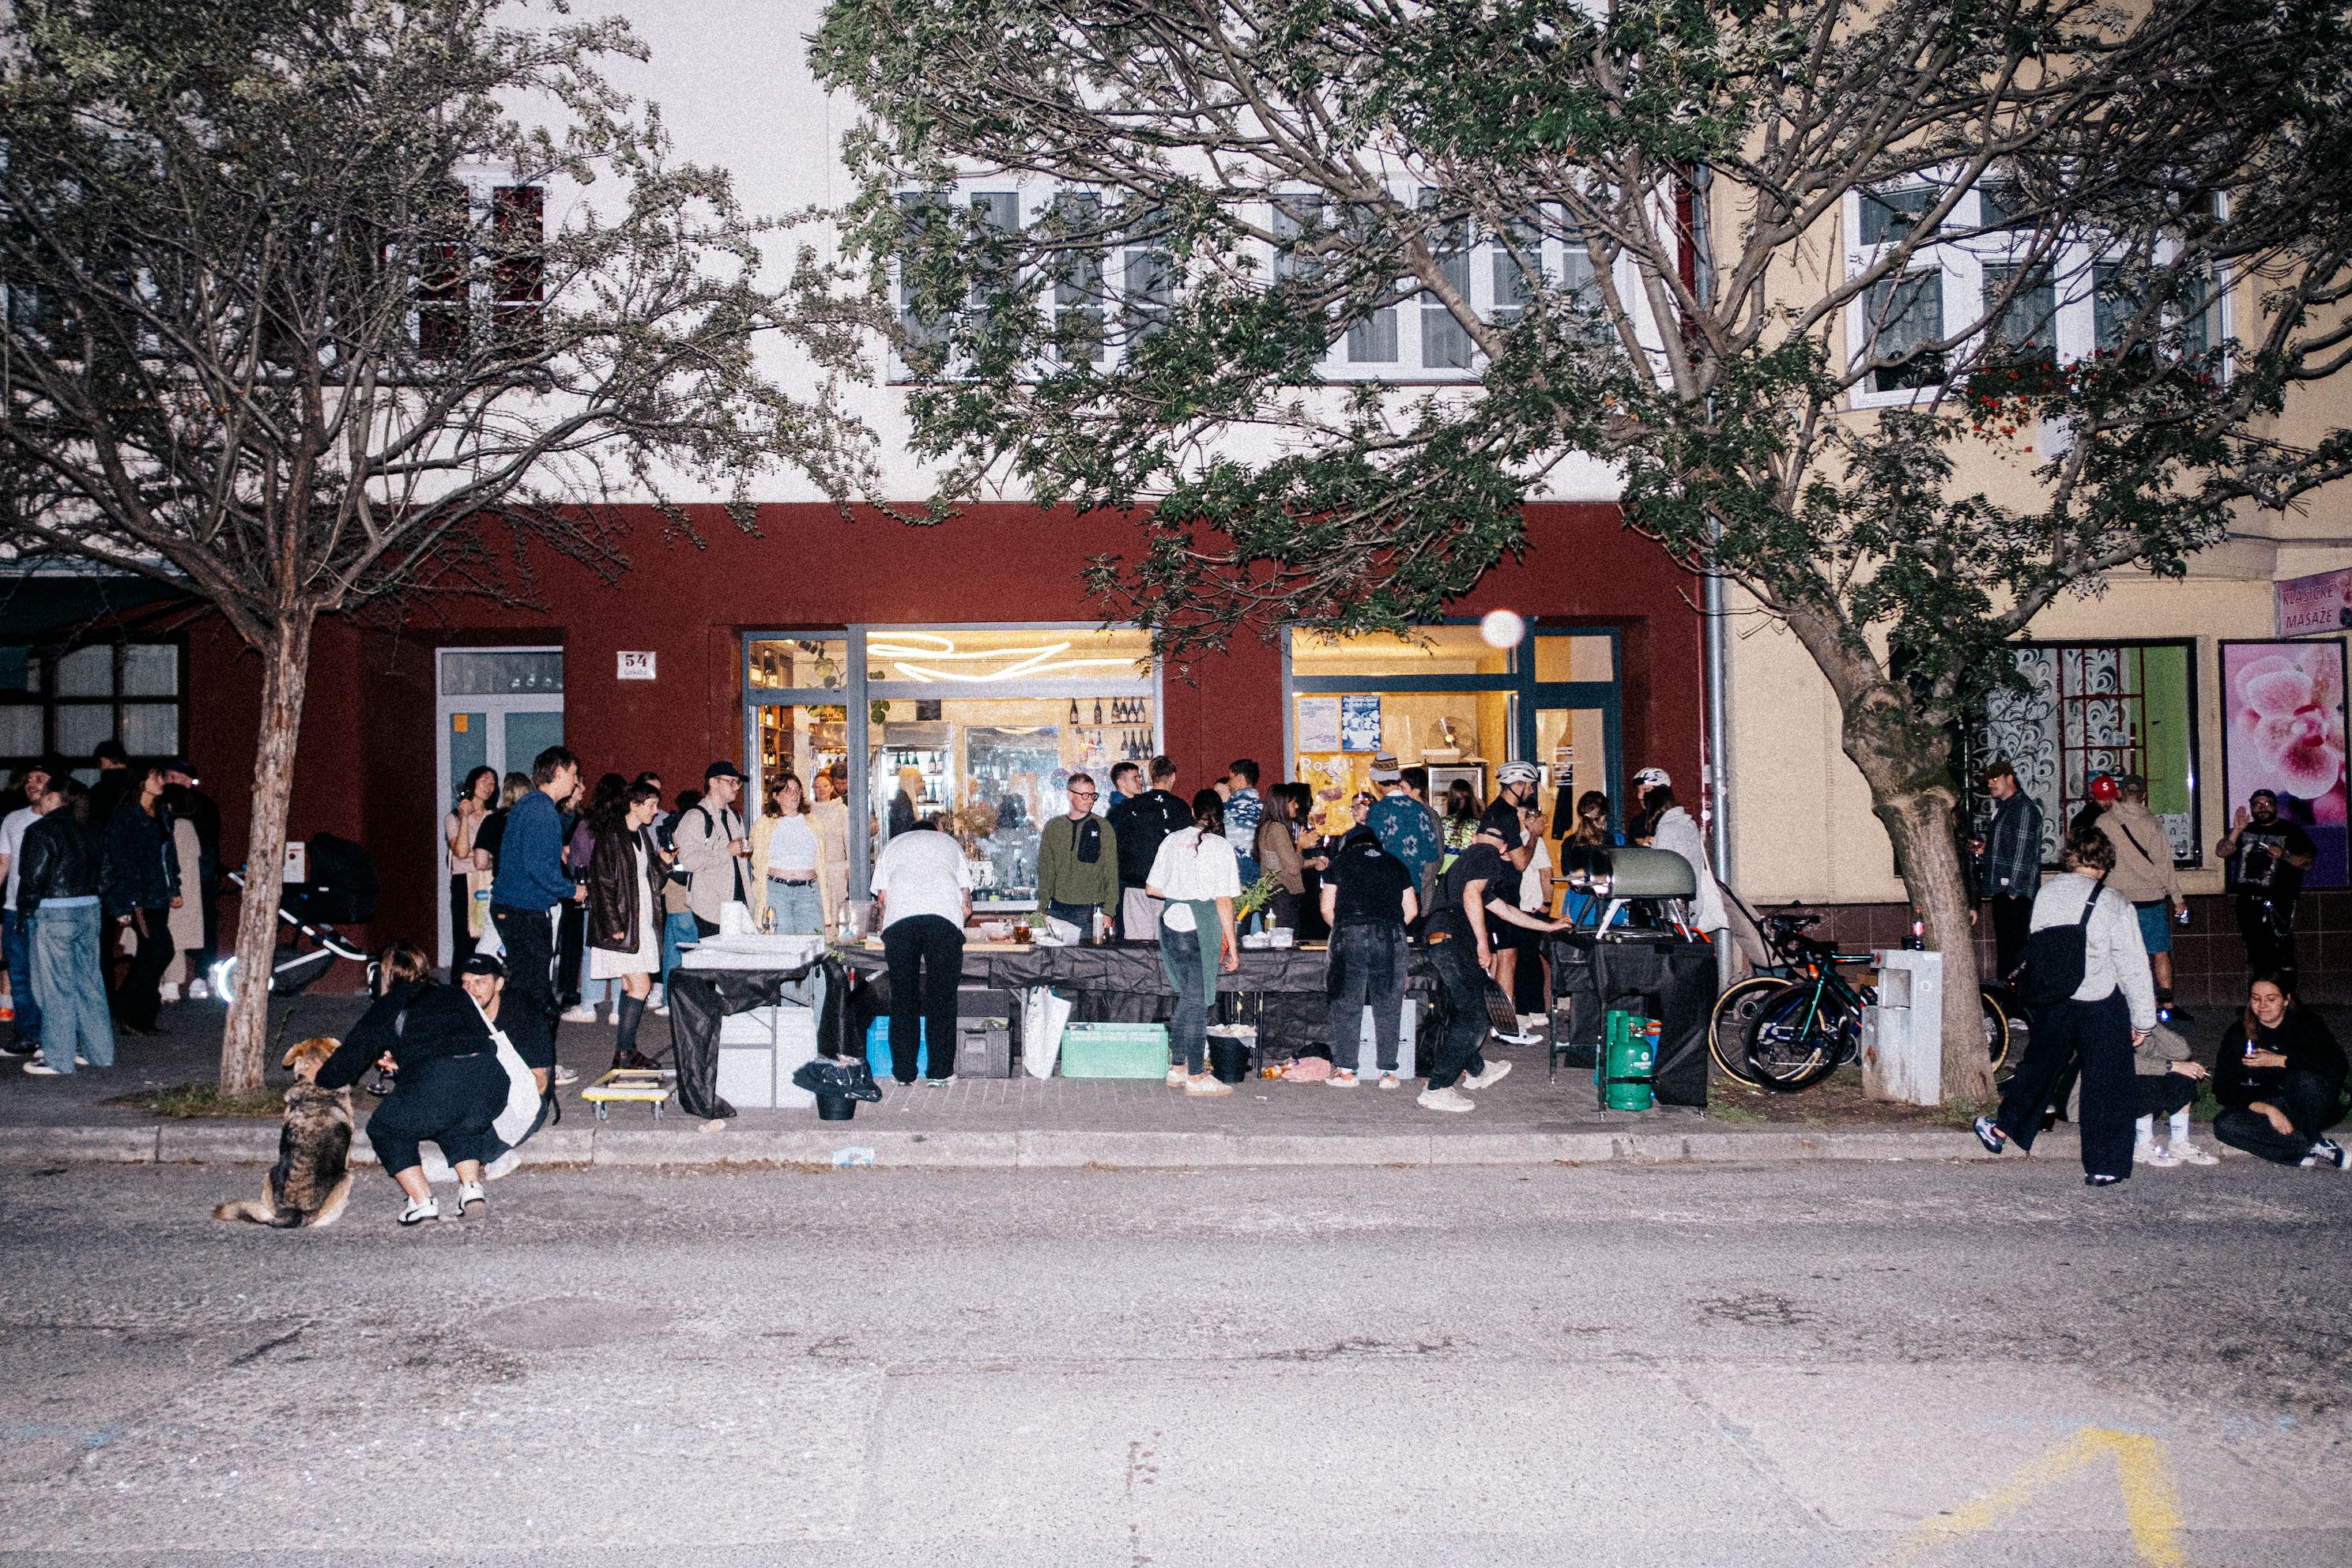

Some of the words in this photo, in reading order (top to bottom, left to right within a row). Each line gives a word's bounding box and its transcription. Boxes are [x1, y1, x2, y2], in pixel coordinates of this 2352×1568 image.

[2282, 581, 2335, 605] KLASICKÉ
[625, 654, 647, 667] 54
[2102, 782, 2109, 791] S
